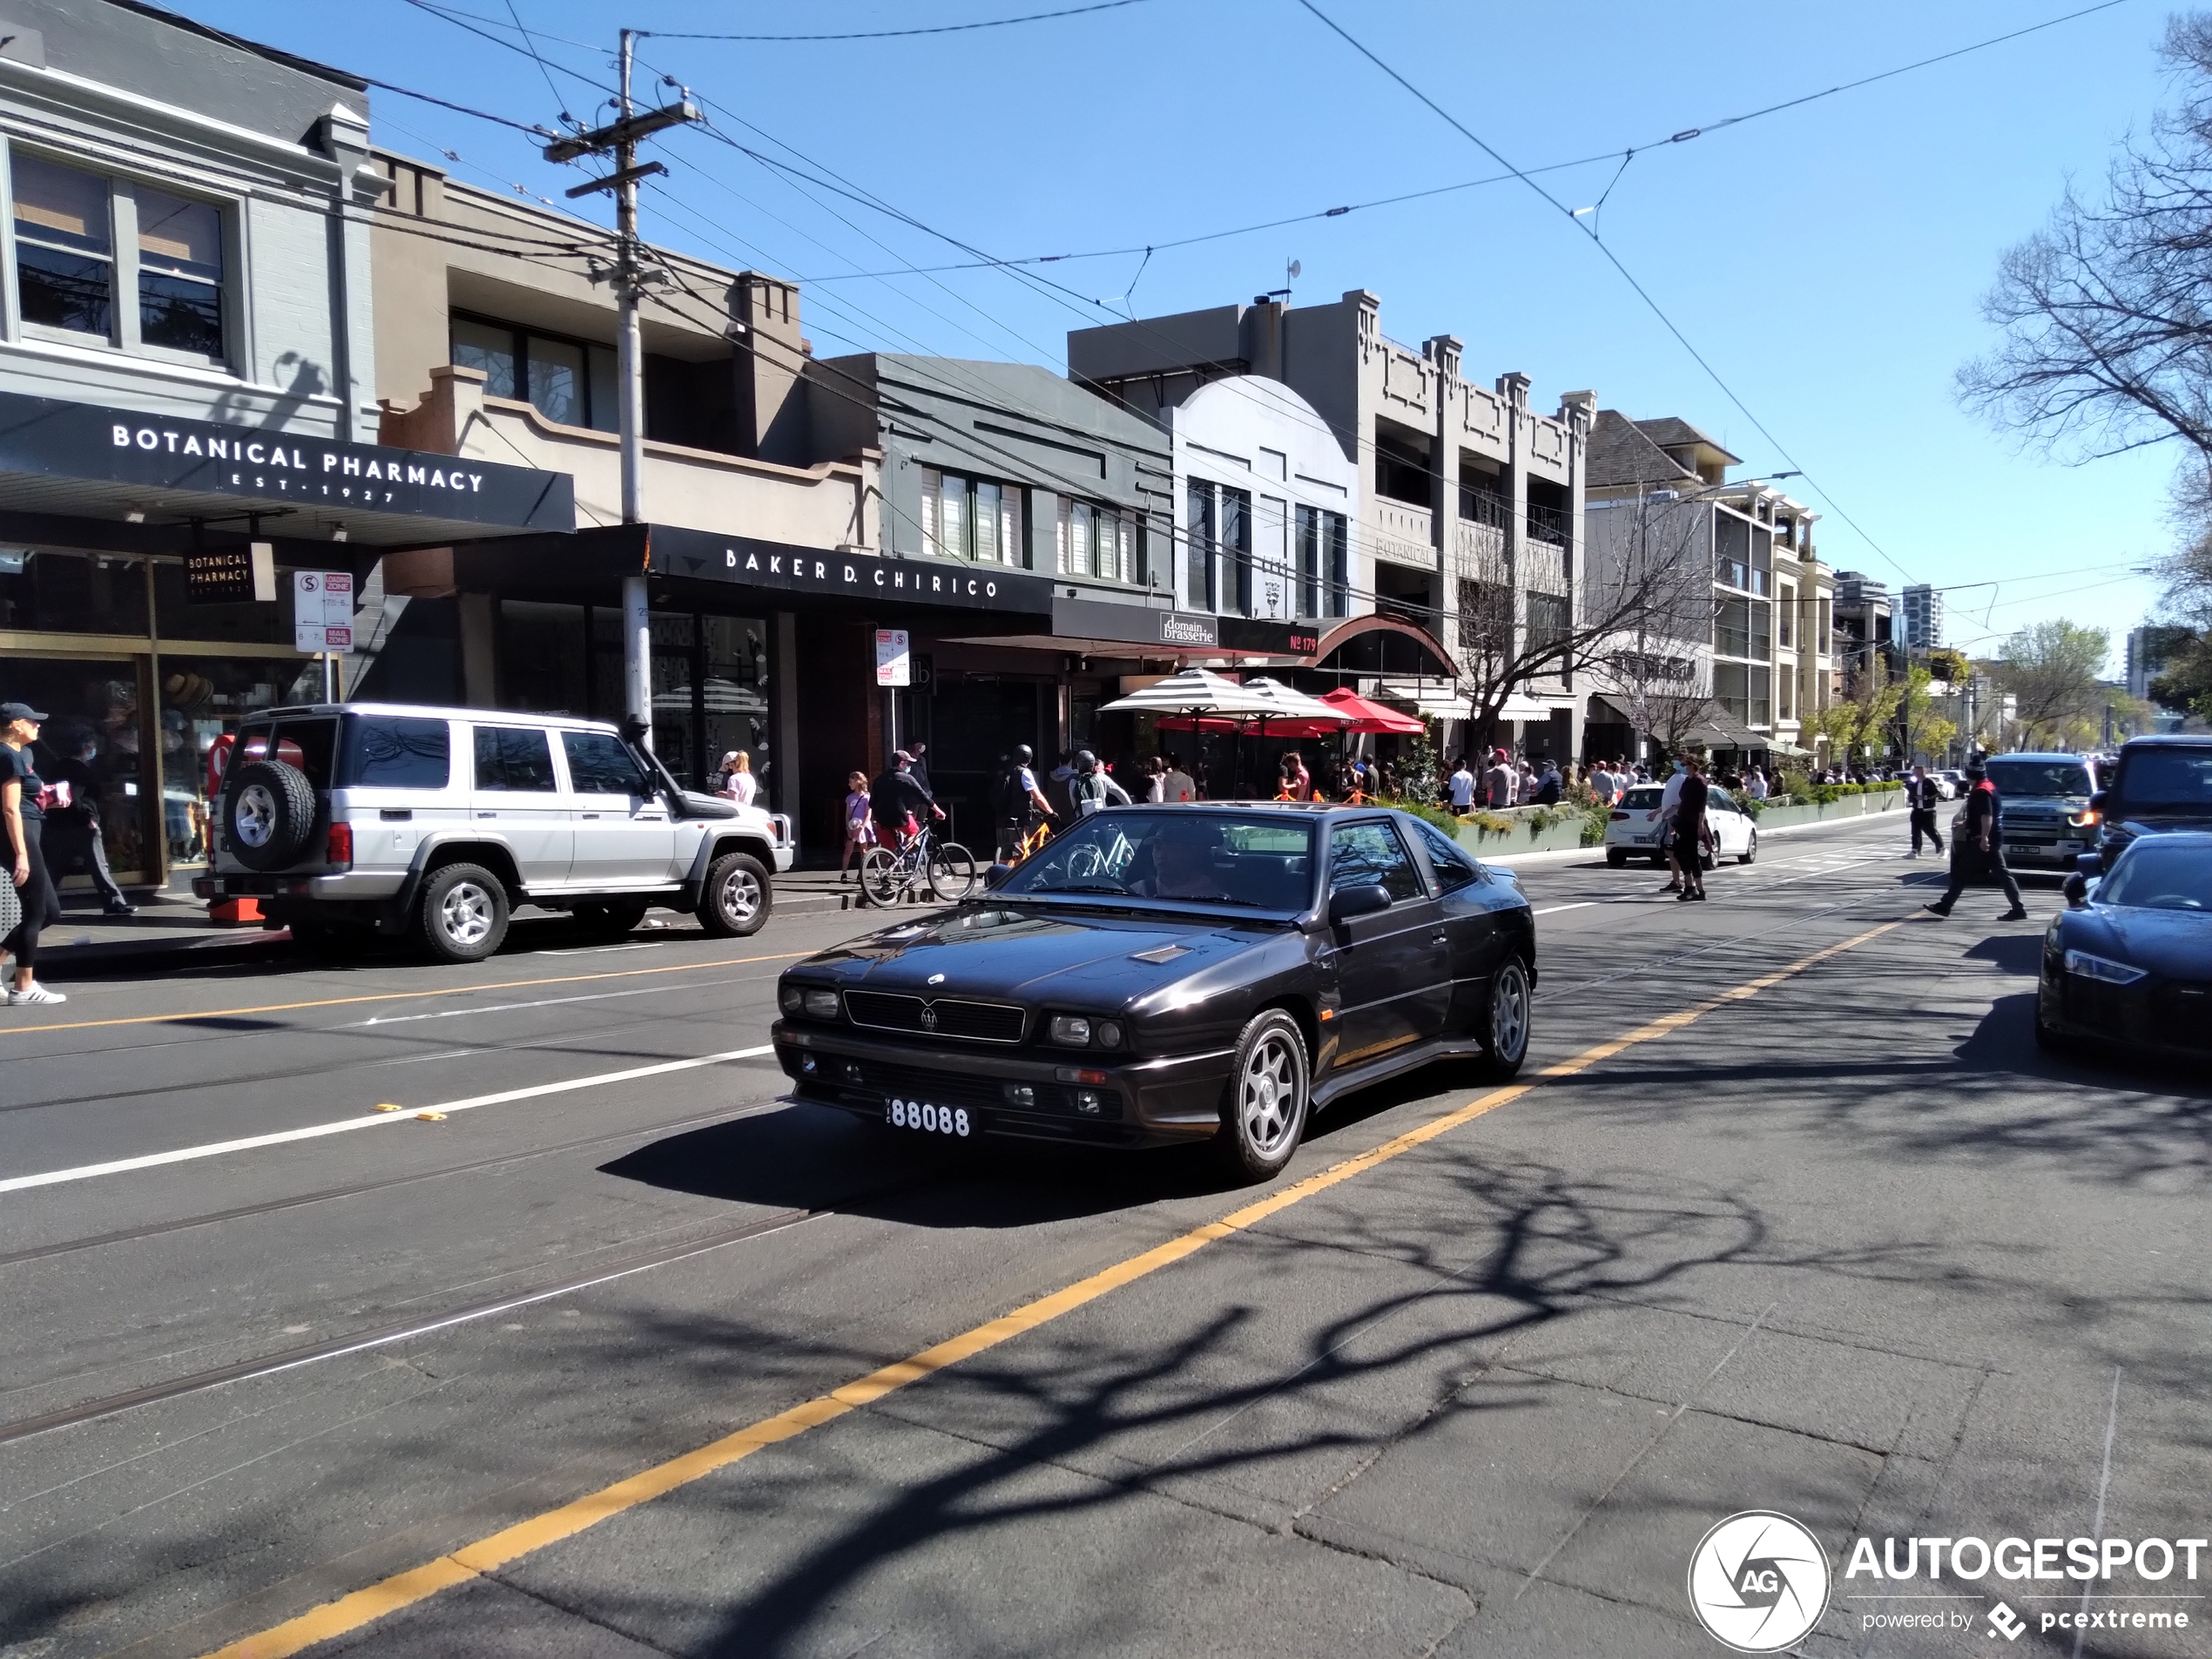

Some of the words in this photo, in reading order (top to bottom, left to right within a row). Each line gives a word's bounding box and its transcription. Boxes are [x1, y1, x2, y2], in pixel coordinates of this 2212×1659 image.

[113, 425, 307, 469] BOTANICAL
[323, 454, 482, 492] PHARMACY
[1376, 536, 1433, 566] BOTANICAL
[189, 554, 247, 569] BOTANICAL
[191, 570, 247, 583] PHARMACY
[726, 550, 825, 579] BAKER
[844, 566, 858, 583] D.
[874, 570, 996, 597] CHIRICO
[1163, 624, 1214, 643] brasserie
[1167, 616, 1203, 632] domain
[1303, 637, 1317, 651] 179
[892, 1099, 969, 1137] 88088
